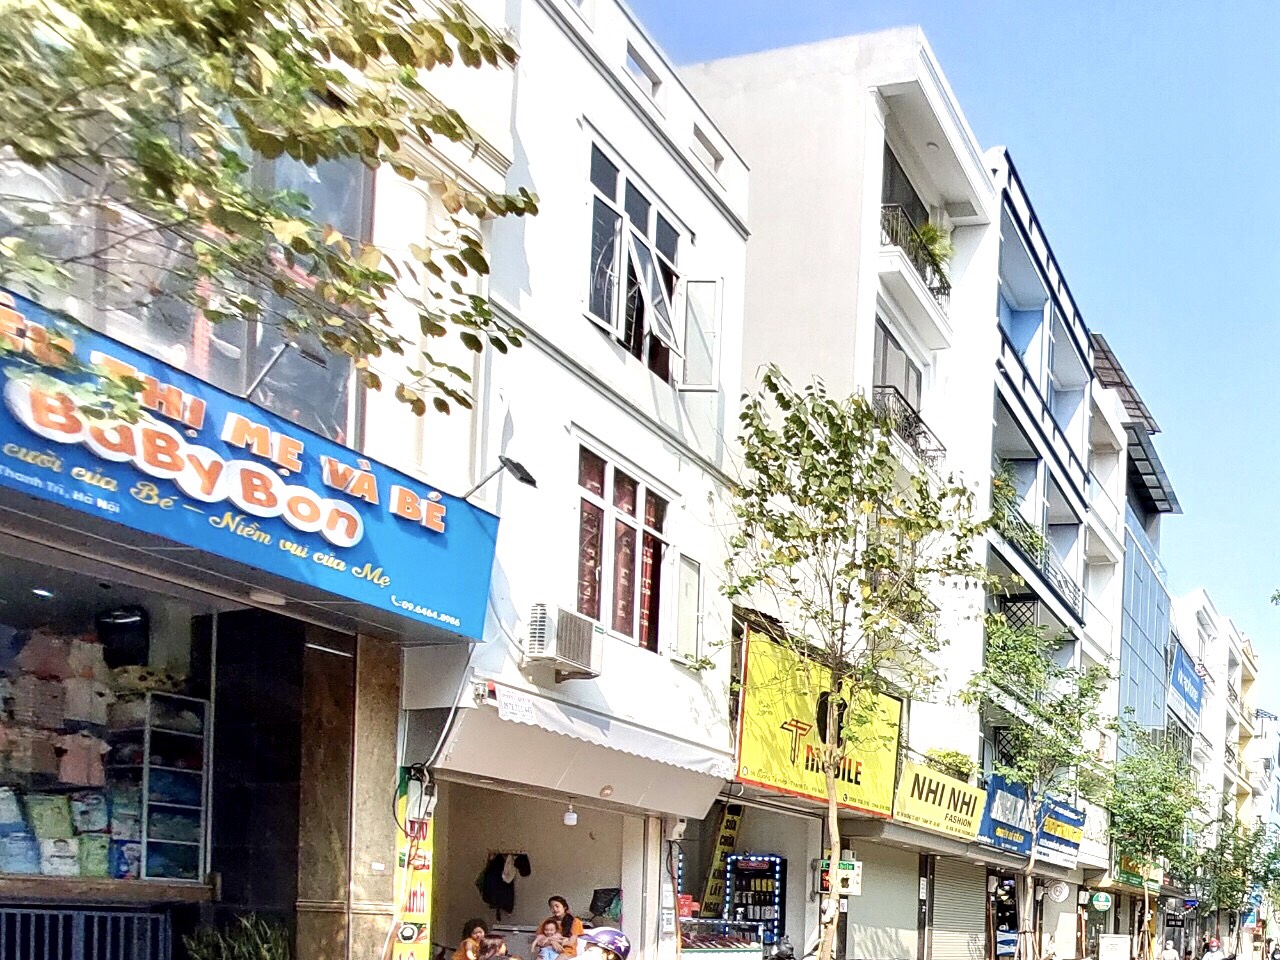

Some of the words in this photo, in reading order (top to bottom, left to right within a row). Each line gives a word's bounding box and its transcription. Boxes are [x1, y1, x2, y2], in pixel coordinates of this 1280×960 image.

[221, 411, 304, 477] MẸ
[320, 454, 380, 505] VÀ
[388, 484, 447, 533] BÉ
[129, 480, 179, 511] Bé
[208, 510, 272, 546] Niềm
[278, 538, 309, 558] vui
[312, 551, 348, 572] của
[351, 563, 391, 588] Mẹ
[910, 772, 946, 807] NHI
[947, 786, 978, 818] NHI
[944, 812, 973, 829] FASHION
